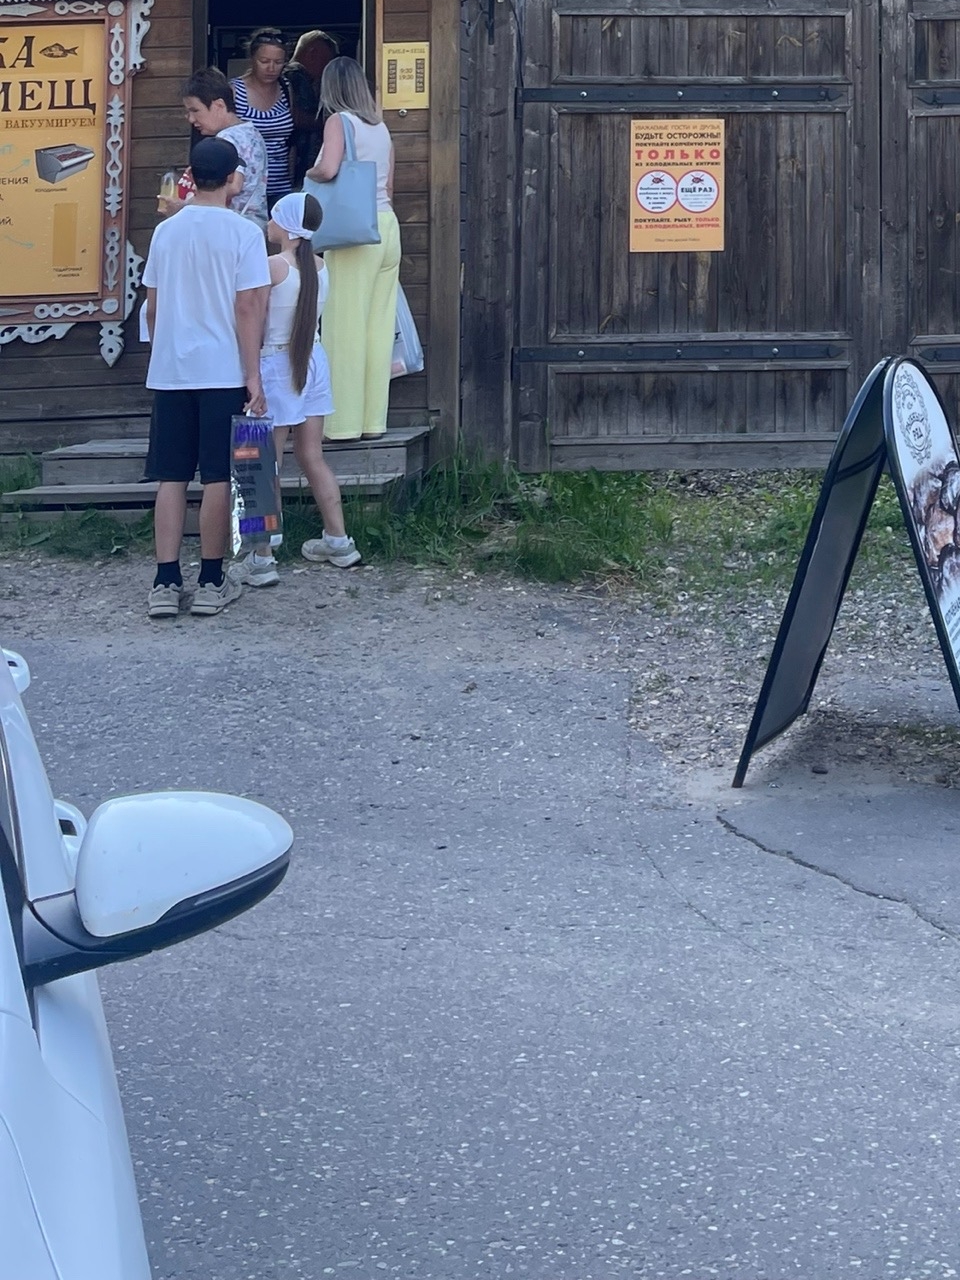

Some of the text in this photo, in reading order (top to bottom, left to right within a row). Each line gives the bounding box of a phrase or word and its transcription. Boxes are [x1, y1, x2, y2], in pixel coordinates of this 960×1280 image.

[5, 117, 97, 129] ВАКУУМИРУЕМ
[635, 132, 663, 140] БУДЬТЕ
[635, 149, 721, 160] ТОЛЬКО
[0, 176, 29, 185] ЕНИЯ
